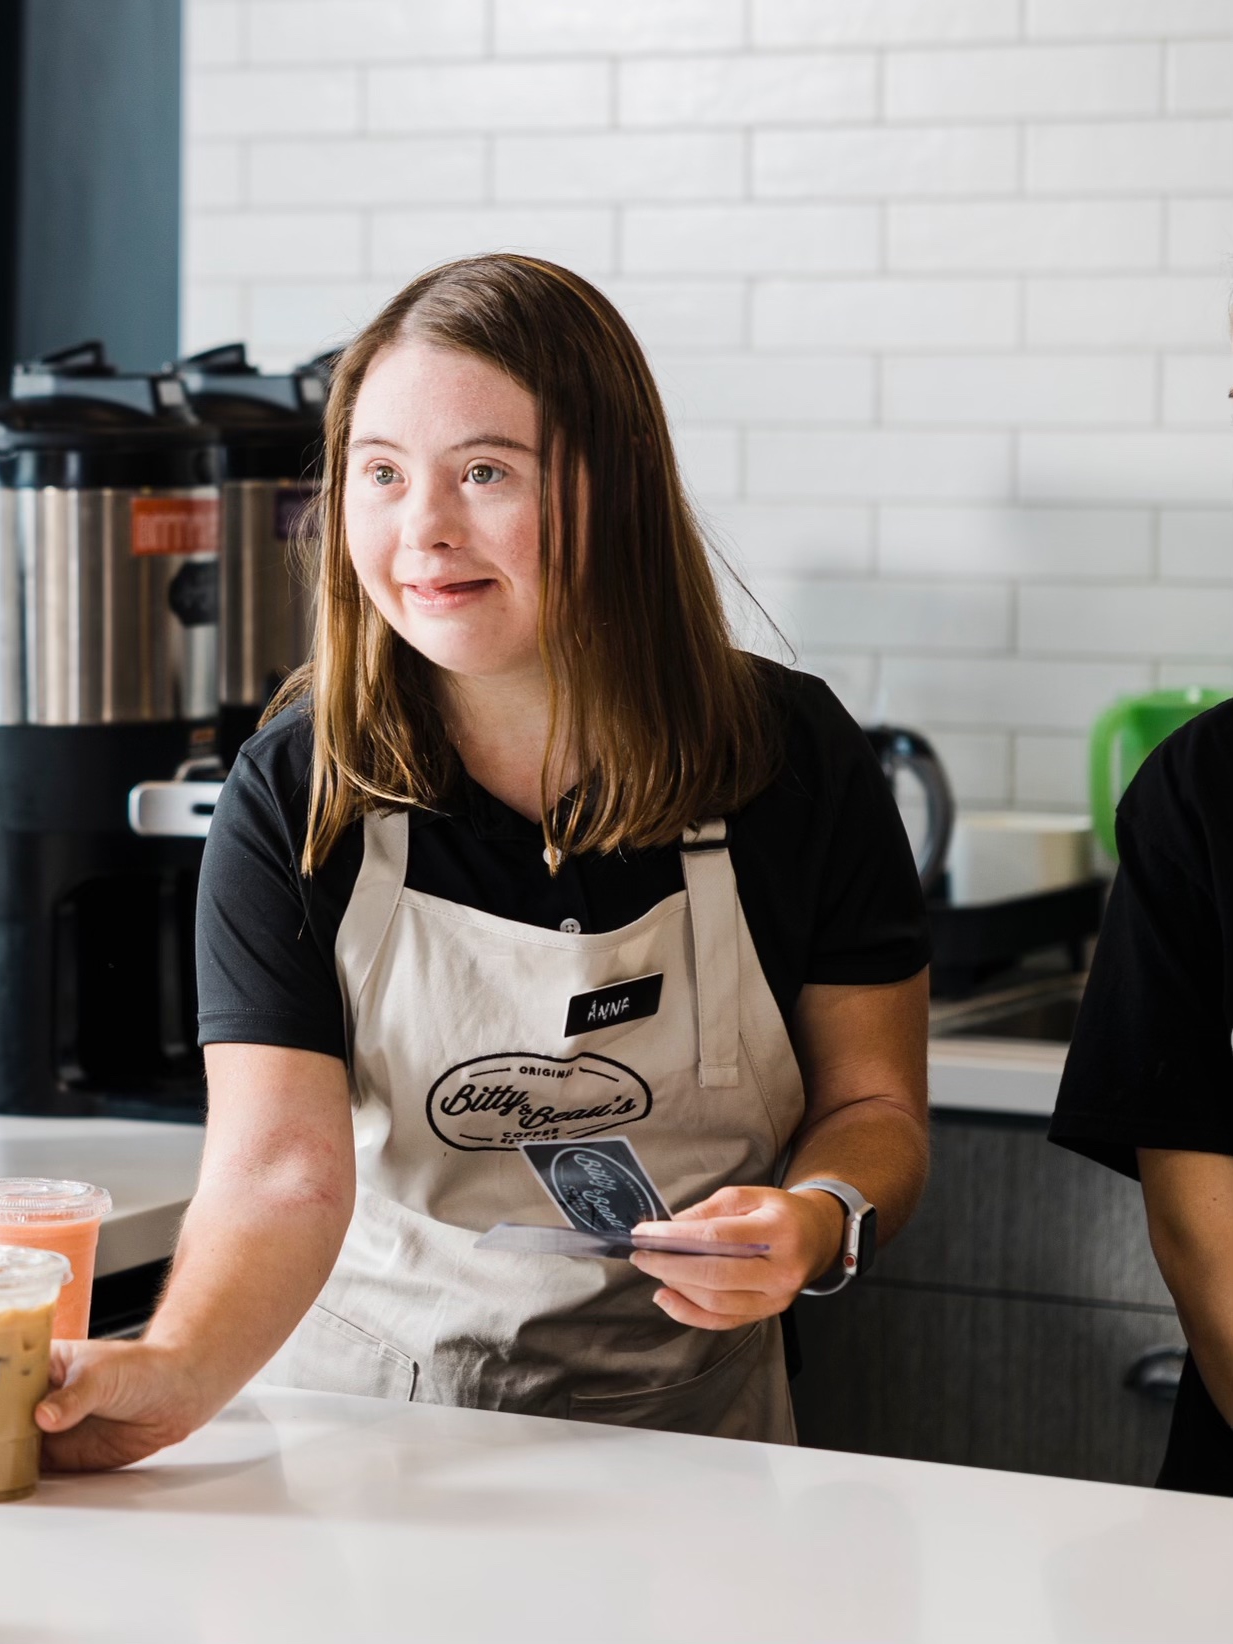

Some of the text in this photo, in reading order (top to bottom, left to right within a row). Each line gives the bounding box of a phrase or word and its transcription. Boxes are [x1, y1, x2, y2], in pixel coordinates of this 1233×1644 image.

[519, 1066, 574, 1078] ORIGIN
[440, 1084, 637, 1129] Bitty & Beau's
[502, 1128, 559, 1137] COFFEE
[574, 1153, 617, 1192] Bitty
